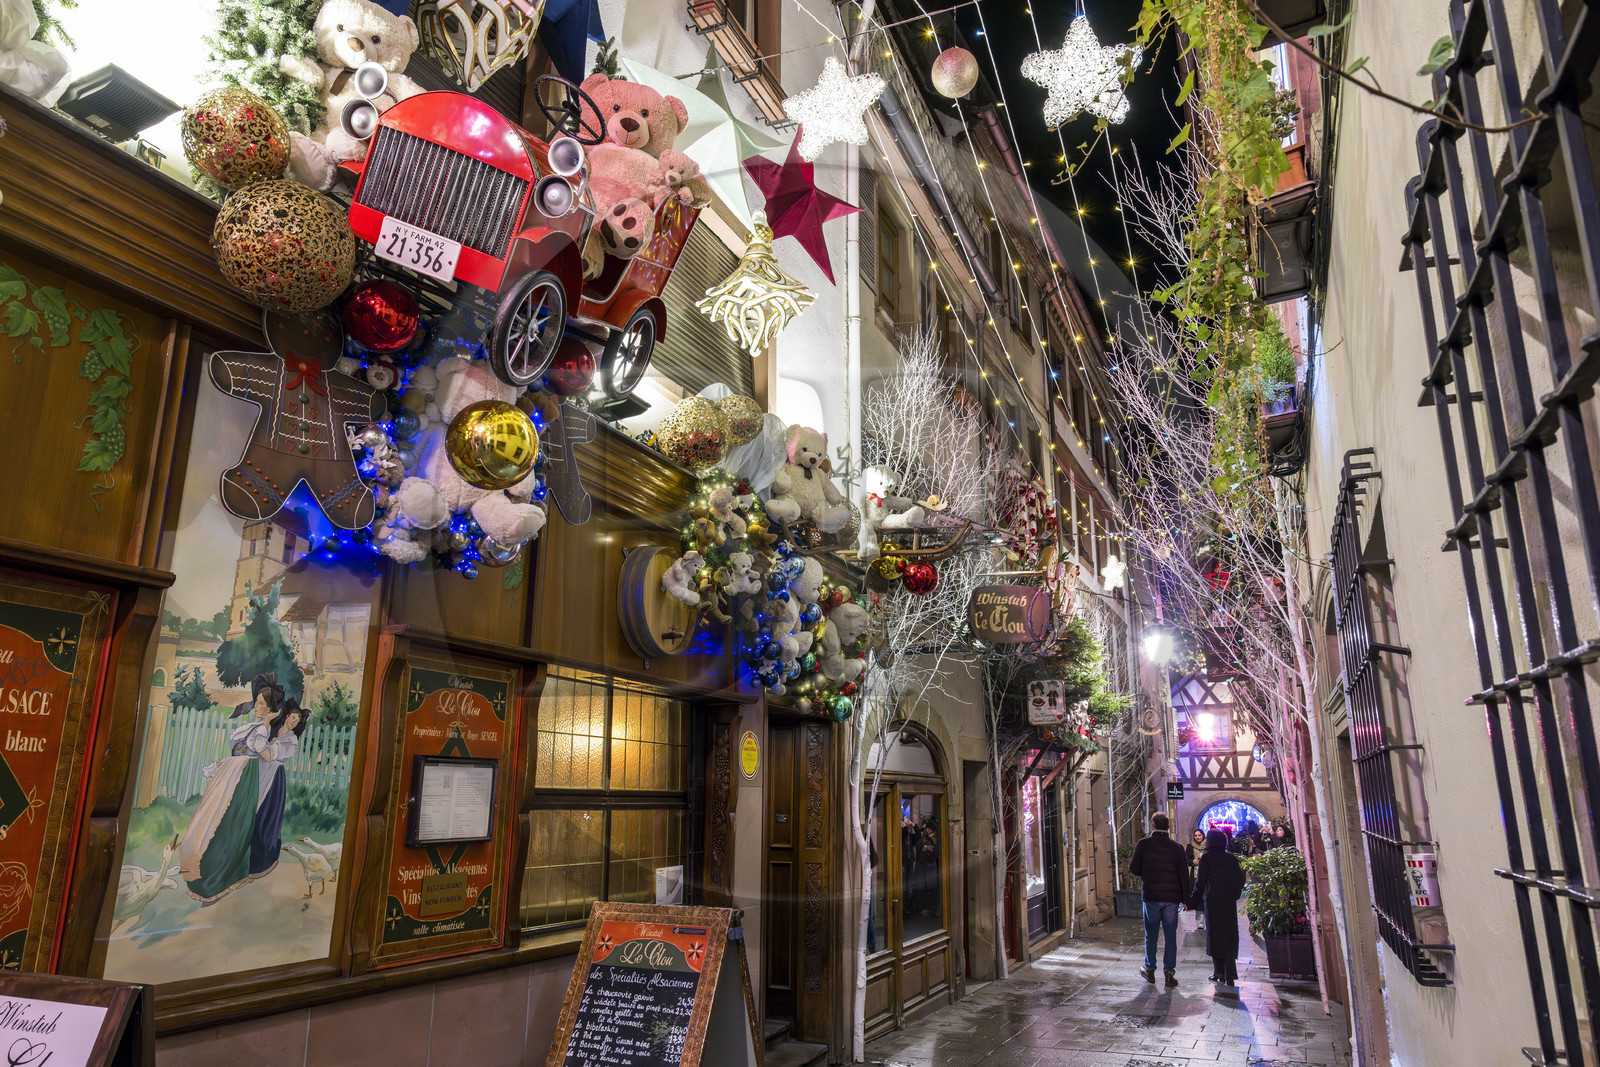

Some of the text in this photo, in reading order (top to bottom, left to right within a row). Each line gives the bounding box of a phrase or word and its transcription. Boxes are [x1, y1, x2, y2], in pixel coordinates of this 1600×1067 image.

[410, 231, 432, 245] FARM
[434, 240, 445, 250] 42
[976, 592, 1027, 607] Winstub
[974, 605, 1026, 633] Le Clou
[447, 674, 474, 689] Winstub
[435, 690, 481, 720] Le Clou
[5, 729, 47, 752] blanc
[397, 862, 488, 885] Spécialités Alsaciennes
[426, 881, 462, 893] RESTAURANT
[403, 888, 422, 905] Vins
[425, 895, 462, 906] NON FUMEUR
[412, 919, 466, 936] salle climatisée
[633, 923, 664, 938] Winstub
[619, 940, 674, 970] Le Clou
[609, 966, 647, 987] Spécialités
[646, 972, 694, 990] Alsaciennes
[597, 986, 632, 999] choucroute
[0, 1000, 63, 1035] Winstub
[614, 1019, 644, 1029] choucroute
